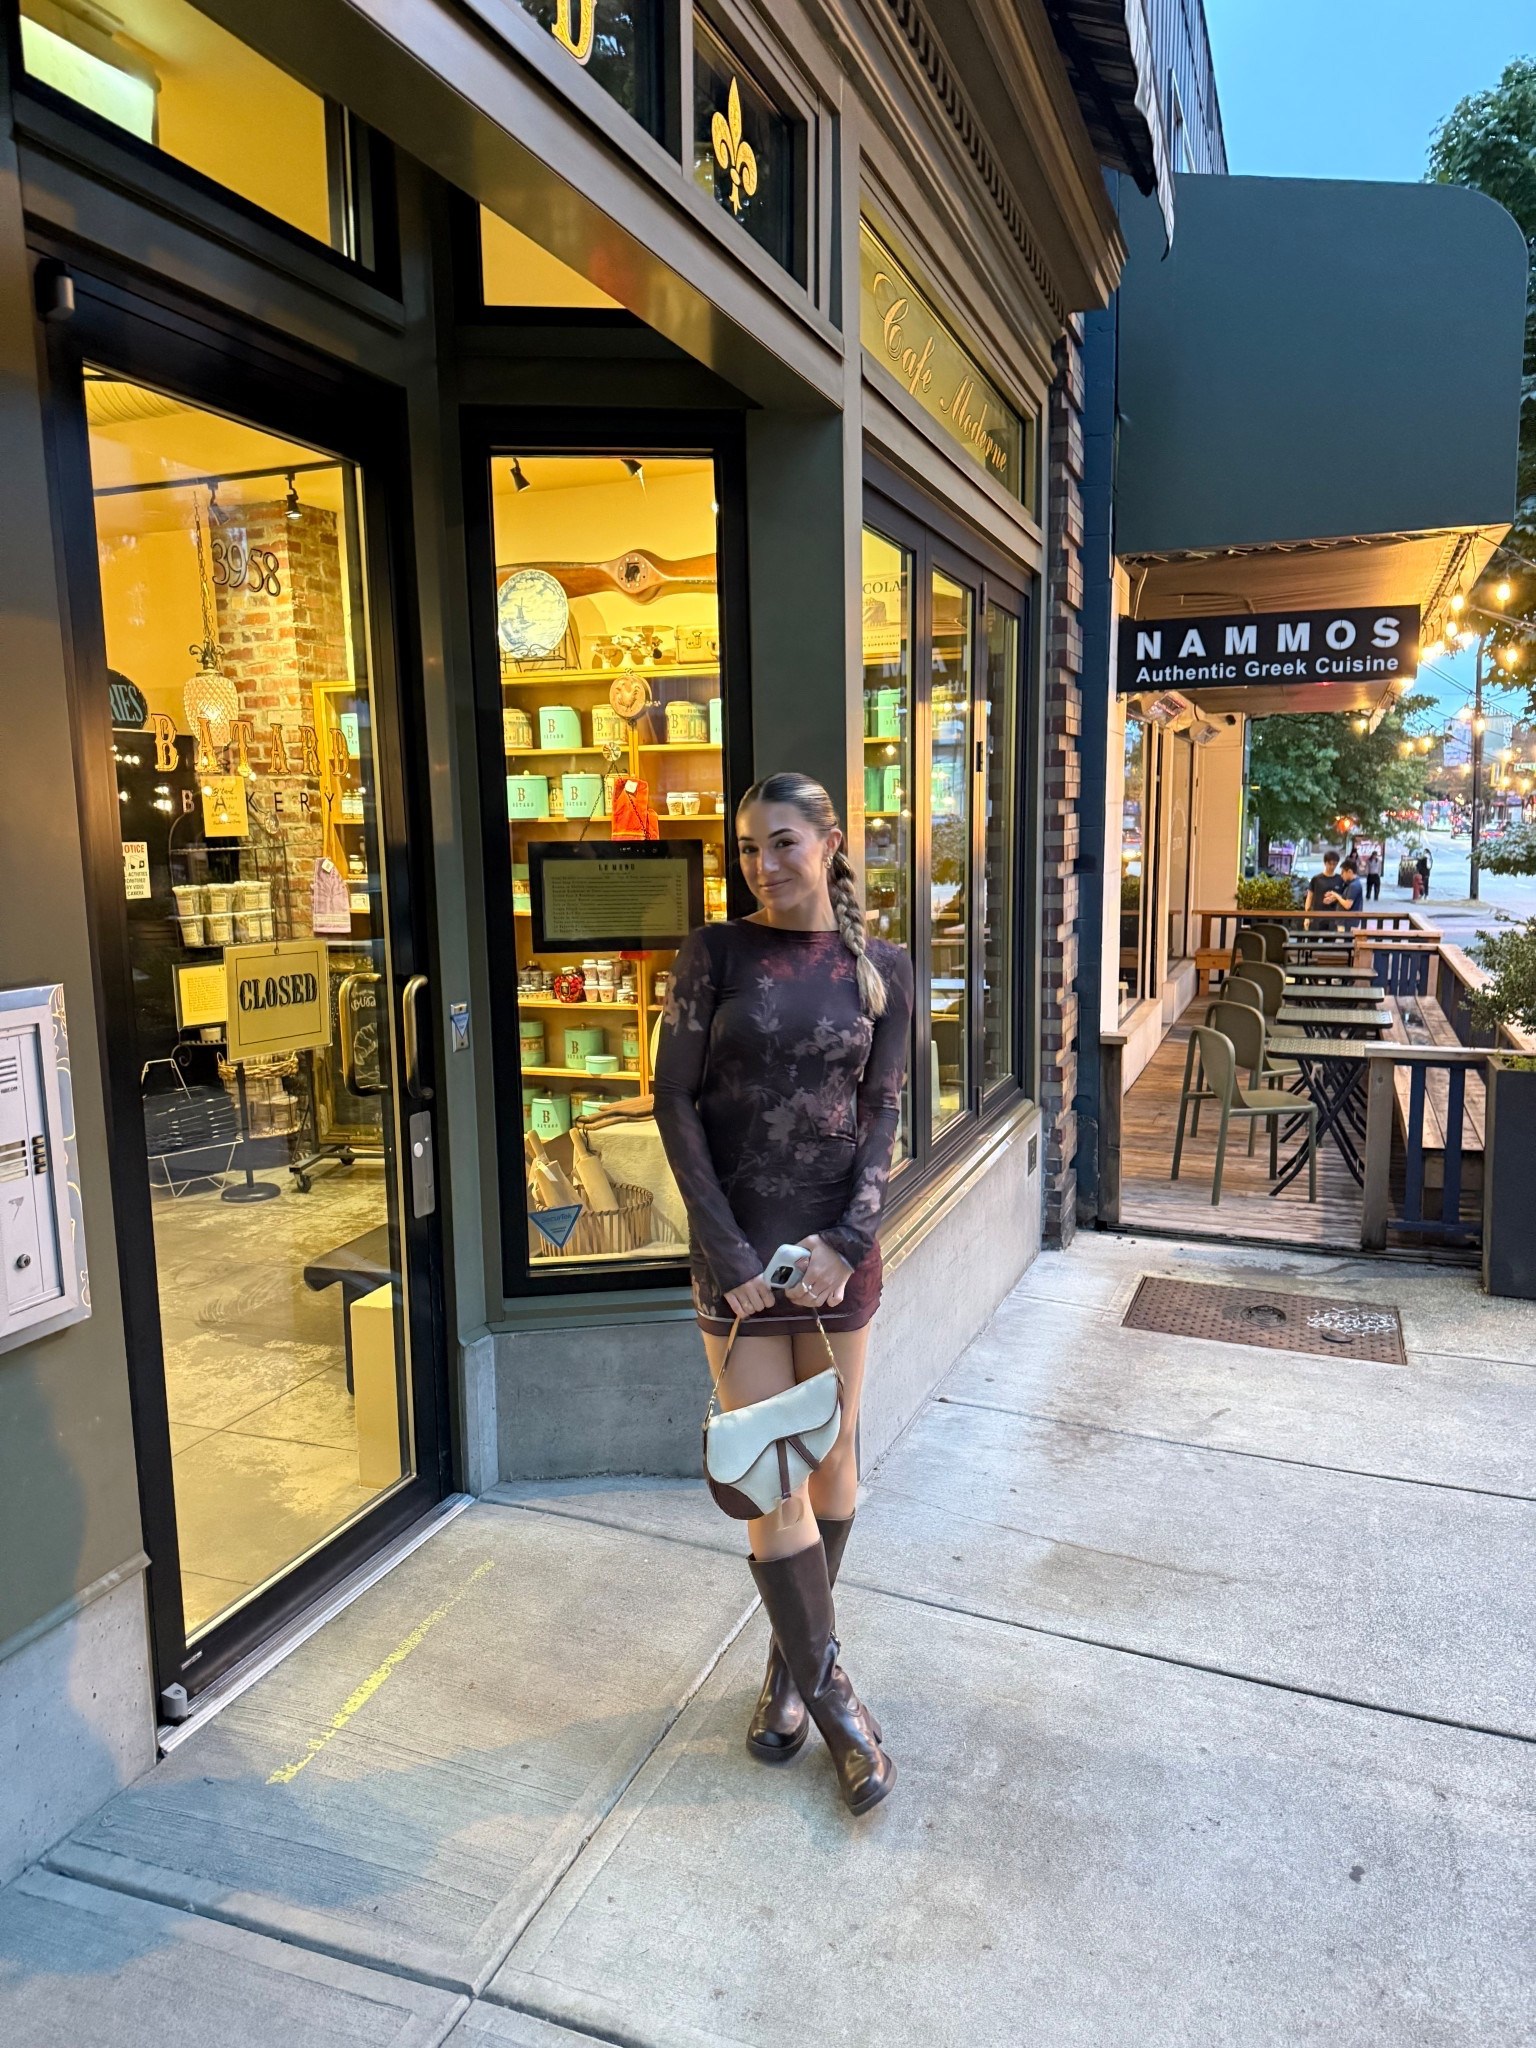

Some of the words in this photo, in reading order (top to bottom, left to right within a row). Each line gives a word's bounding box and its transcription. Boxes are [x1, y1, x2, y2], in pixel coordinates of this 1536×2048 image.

[940, 376, 1007, 472] Moderne
[211, 538, 281, 597] 3958
[1136, 616, 1400, 661] NAMMOS
[1136, 661, 1236, 683] Authentic
[1244, 660, 1306, 677] Greek
[1315, 655, 1399, 675] Cuisine
[547, 719, 556, 733] B
[597, 716, 604, 731] B
[671, 713, 679, 728] B
[151, 713, 350, 777] BATARD
[517, 788, 526, 801] B
[570, 786, 579, 800] B
[181, 789, 335, 813] BAKERY
[124, 844, 145, 854] OTICE
[239, 972, 318, 1012] CLOSED
[571, 1040, 579, 1055] B
[542, 1110, 551, 1124] B
